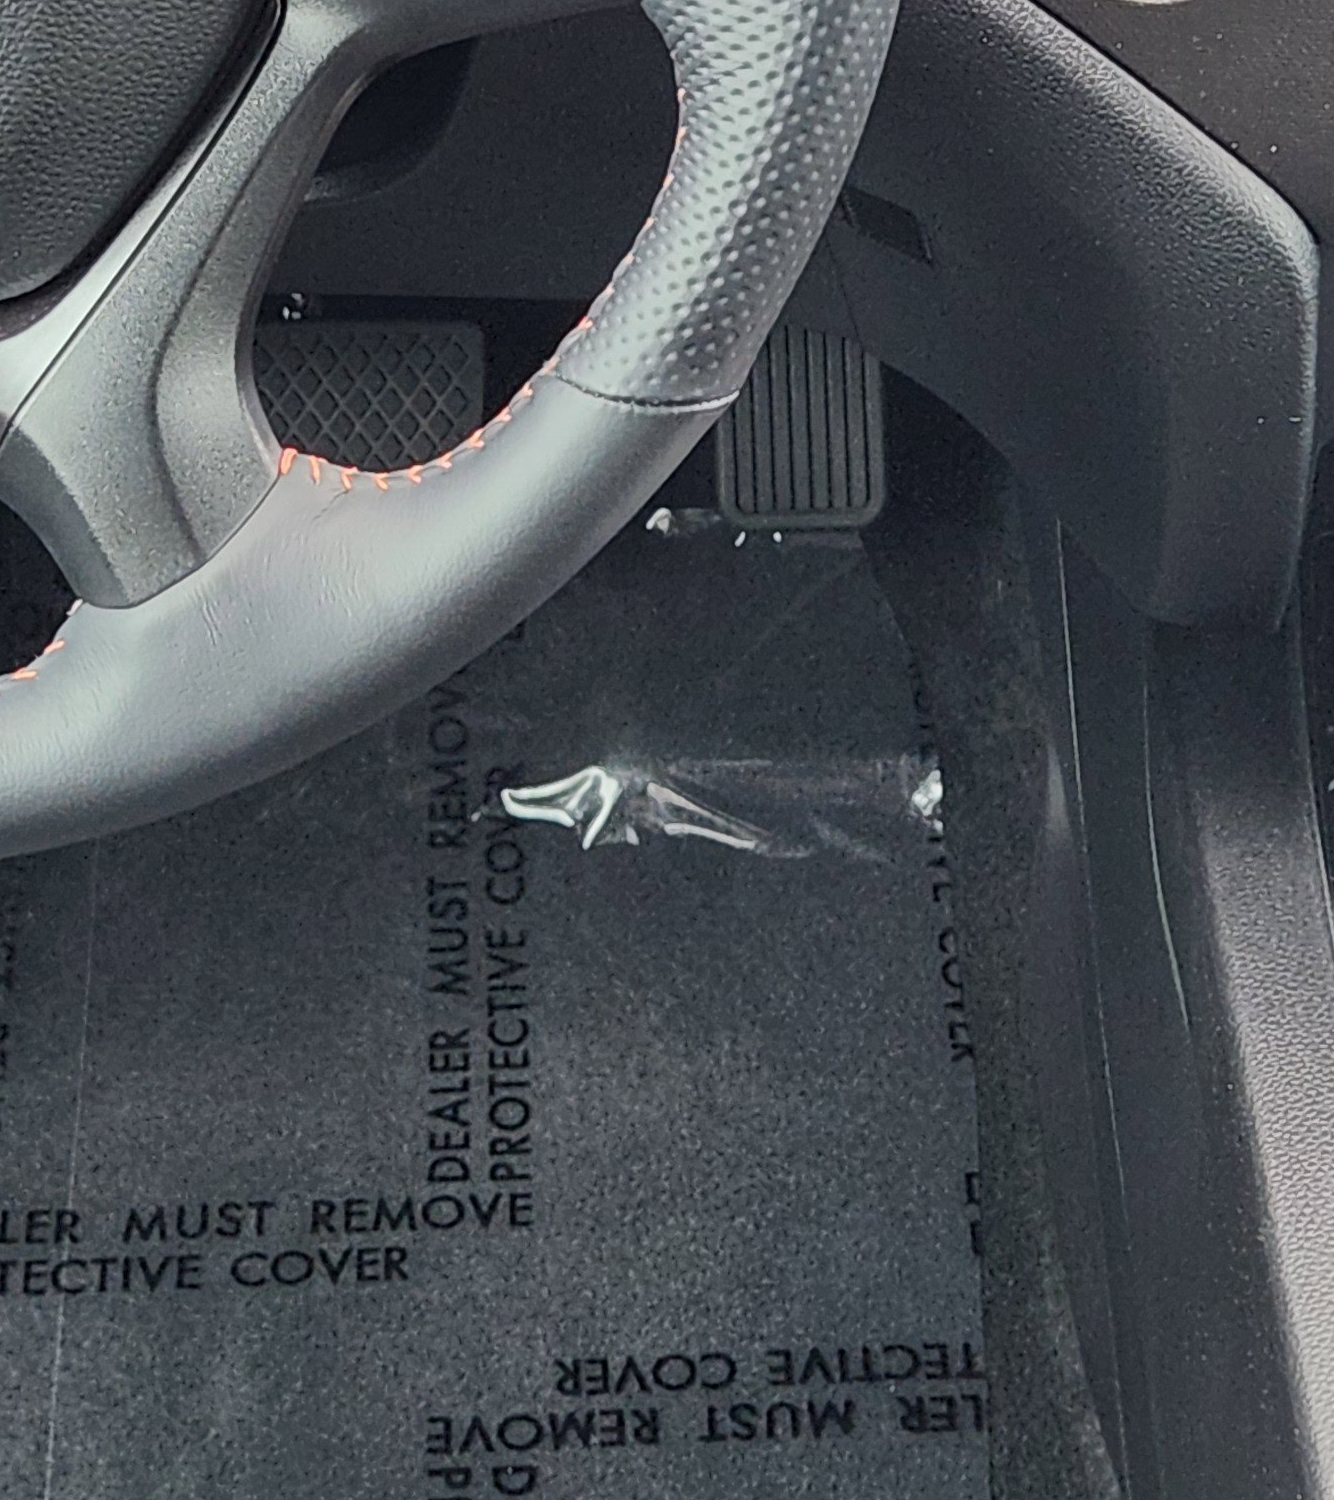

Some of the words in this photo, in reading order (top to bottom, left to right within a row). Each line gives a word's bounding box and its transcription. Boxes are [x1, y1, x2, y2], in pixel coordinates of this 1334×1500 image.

[427, 684, 469, 850] REMOV
[428, 876, 469, 998] MUST
[486, 927, 533, 1186] PROTECTIVE
[428, 1028, 469, 1184] DEALER
[122, 1199, 277, 1244] MUST
[308, 1190, 535, 1237] REMOVE
[229, 1245, 410, 1288] COVER
[554, 1352, 738, 1397] COVER
[425, 1406, 661, 1457] REMOVE
[699, 1400, 857, 1444] MUST
